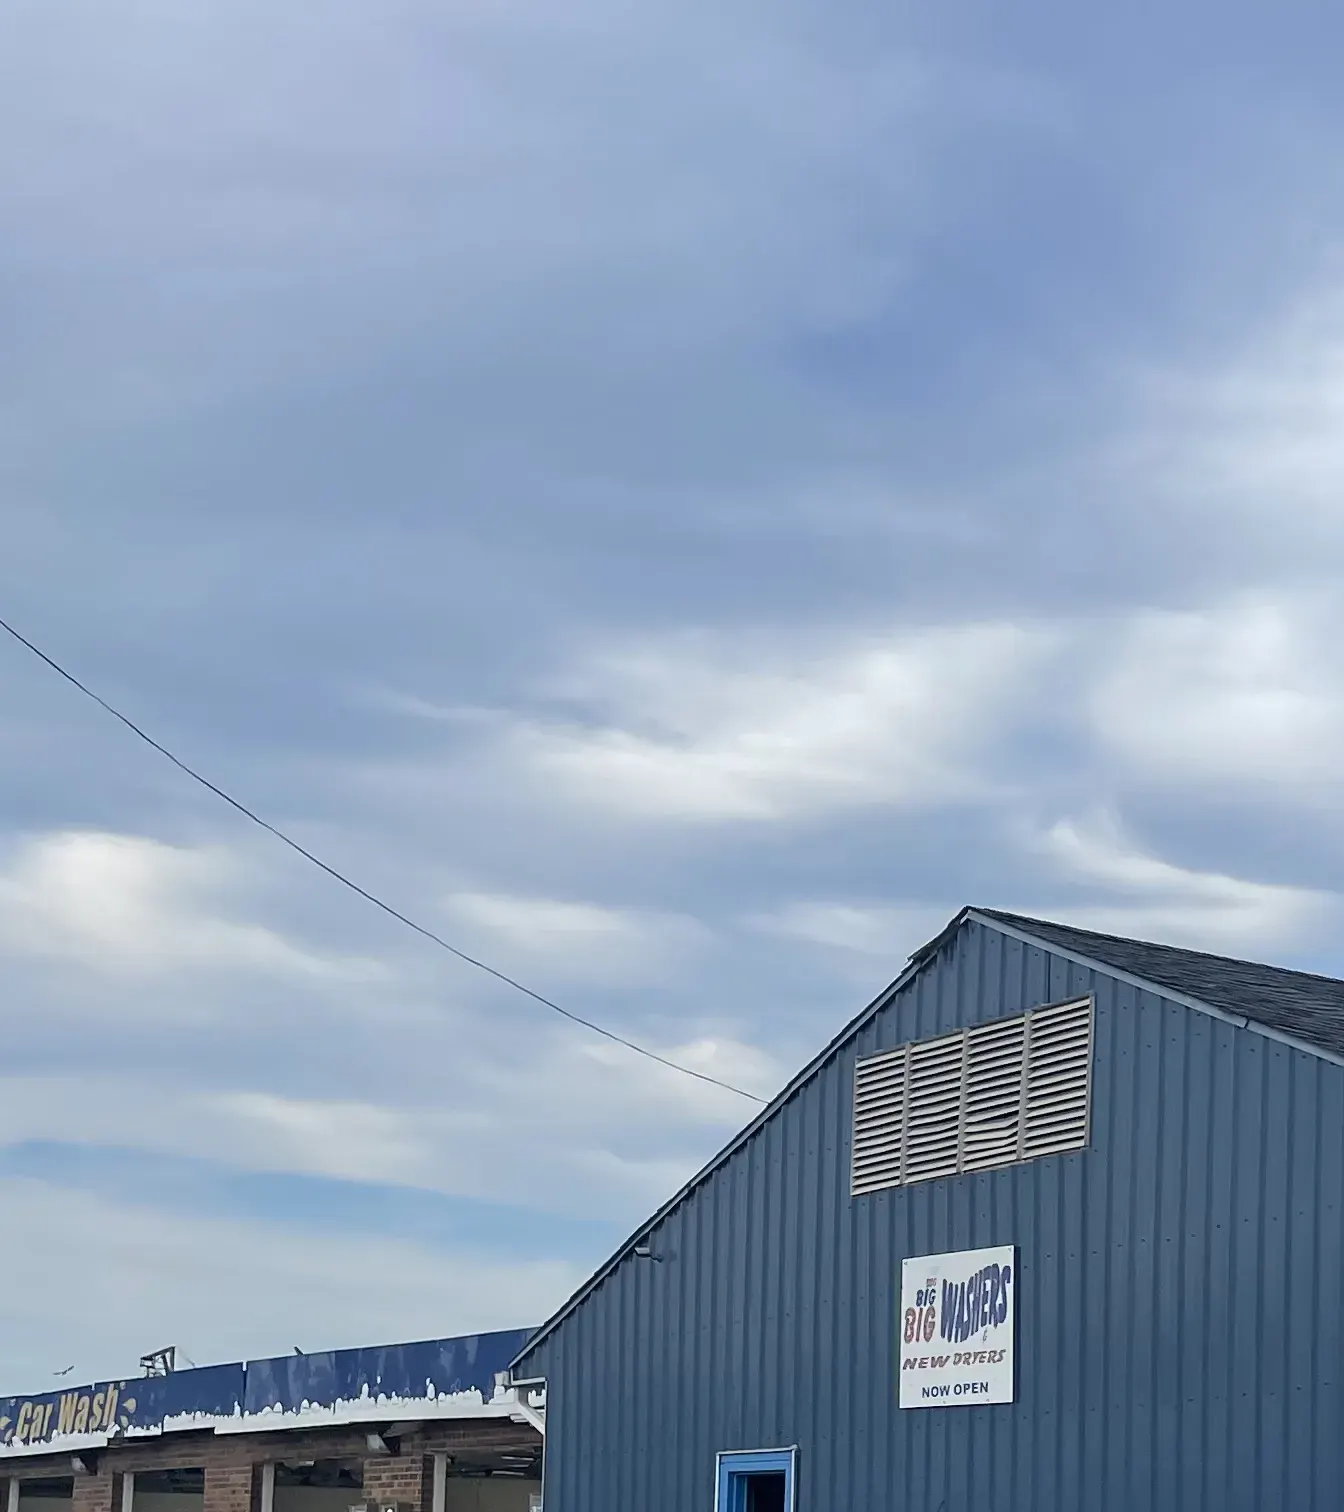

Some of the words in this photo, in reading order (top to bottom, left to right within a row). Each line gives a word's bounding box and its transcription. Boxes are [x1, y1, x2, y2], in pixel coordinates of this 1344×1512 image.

[904, 1305, 936, 1344] BIG
[941, 1263, 1011, 1344] WASHERS
[916, 1288, 936, 1307] BIG
[902, 1355, 950, 1371] NEW
[953, 1349, 1007, 1366] DRYERS
[922, 1384, 950, 1398] NOW
[953, 1382, 989, 1396] OPEN
[15, 1401, 54, 1440] Car
[57, 1383, 119, 1435] Wash
